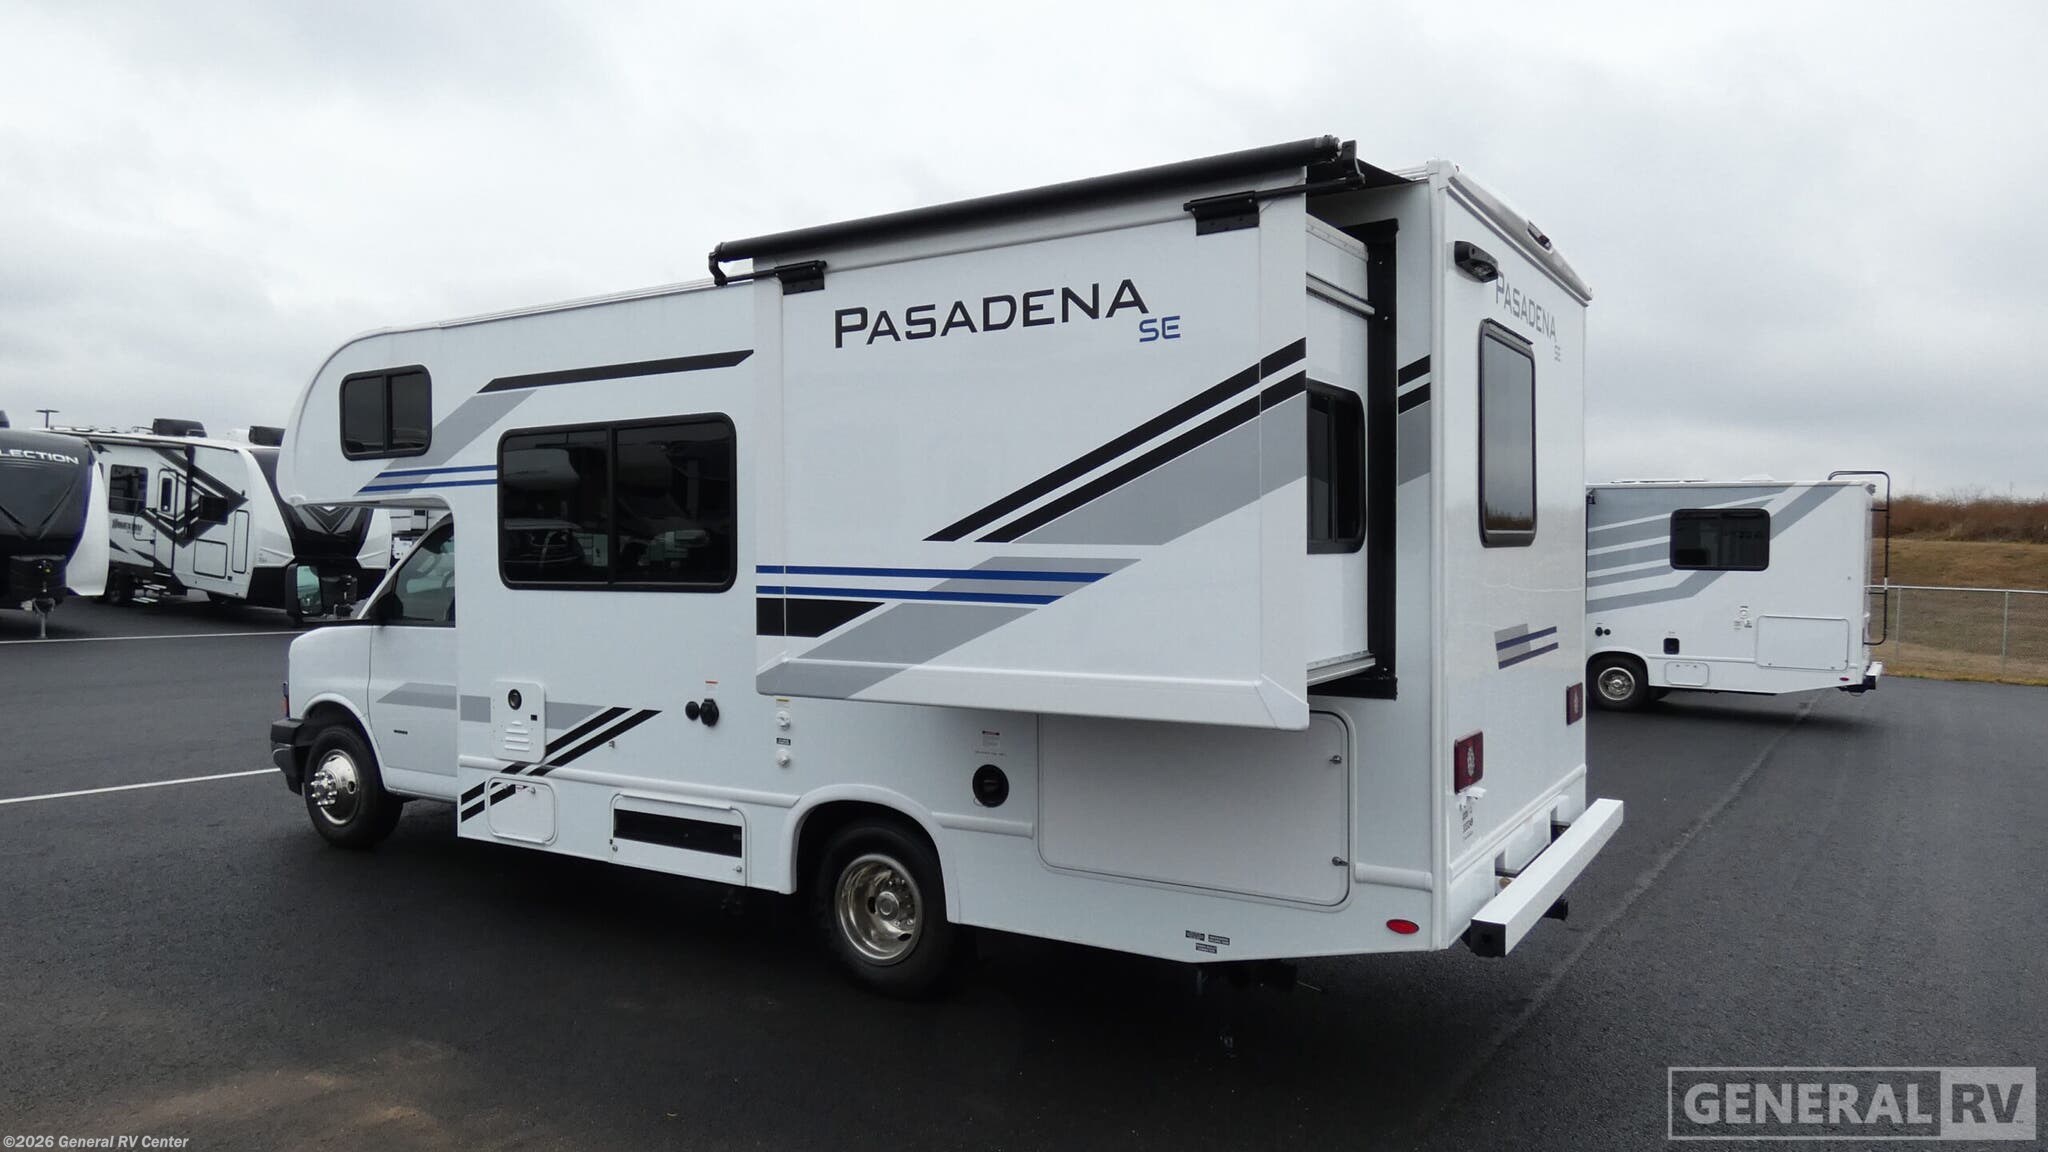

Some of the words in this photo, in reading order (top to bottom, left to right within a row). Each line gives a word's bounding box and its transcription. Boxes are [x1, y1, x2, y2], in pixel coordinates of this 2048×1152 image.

[834, 278, 1150, 349] PASADENA
[1139, 315, 1181, 343] SE
[1496, 271, 1557, 341] PASADENA
